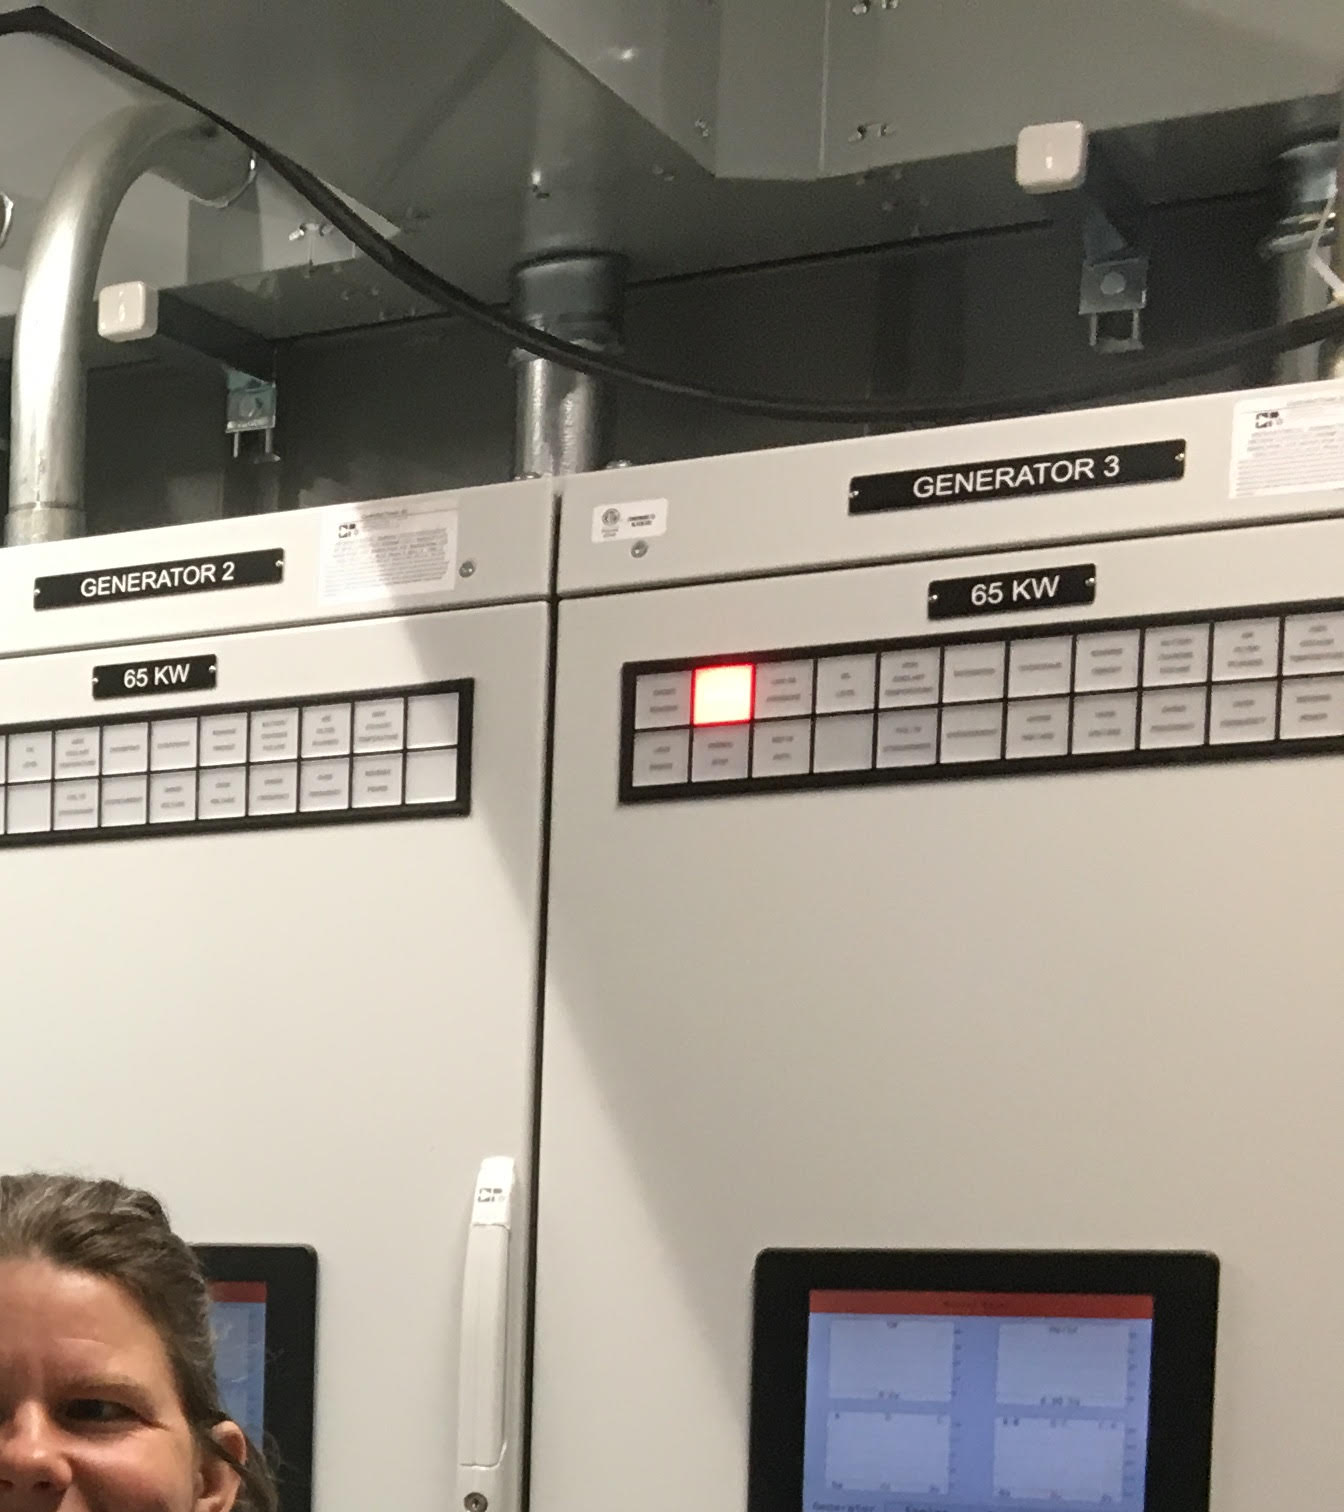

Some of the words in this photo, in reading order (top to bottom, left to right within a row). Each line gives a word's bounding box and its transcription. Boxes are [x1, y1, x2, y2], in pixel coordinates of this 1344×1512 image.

[913, 457, 1095, 499] GENERATOR
[1102, 454, 1121, 479] 3
[79, 563, 218, 598] GENERATOR
[221, 561, 236, 581] 2
[970, 581, 1005, 606] 65
[1011, 575, 1061, 602] KW
[122, 667, 150, 689] 65
[153, 663, 191, 686] KW
